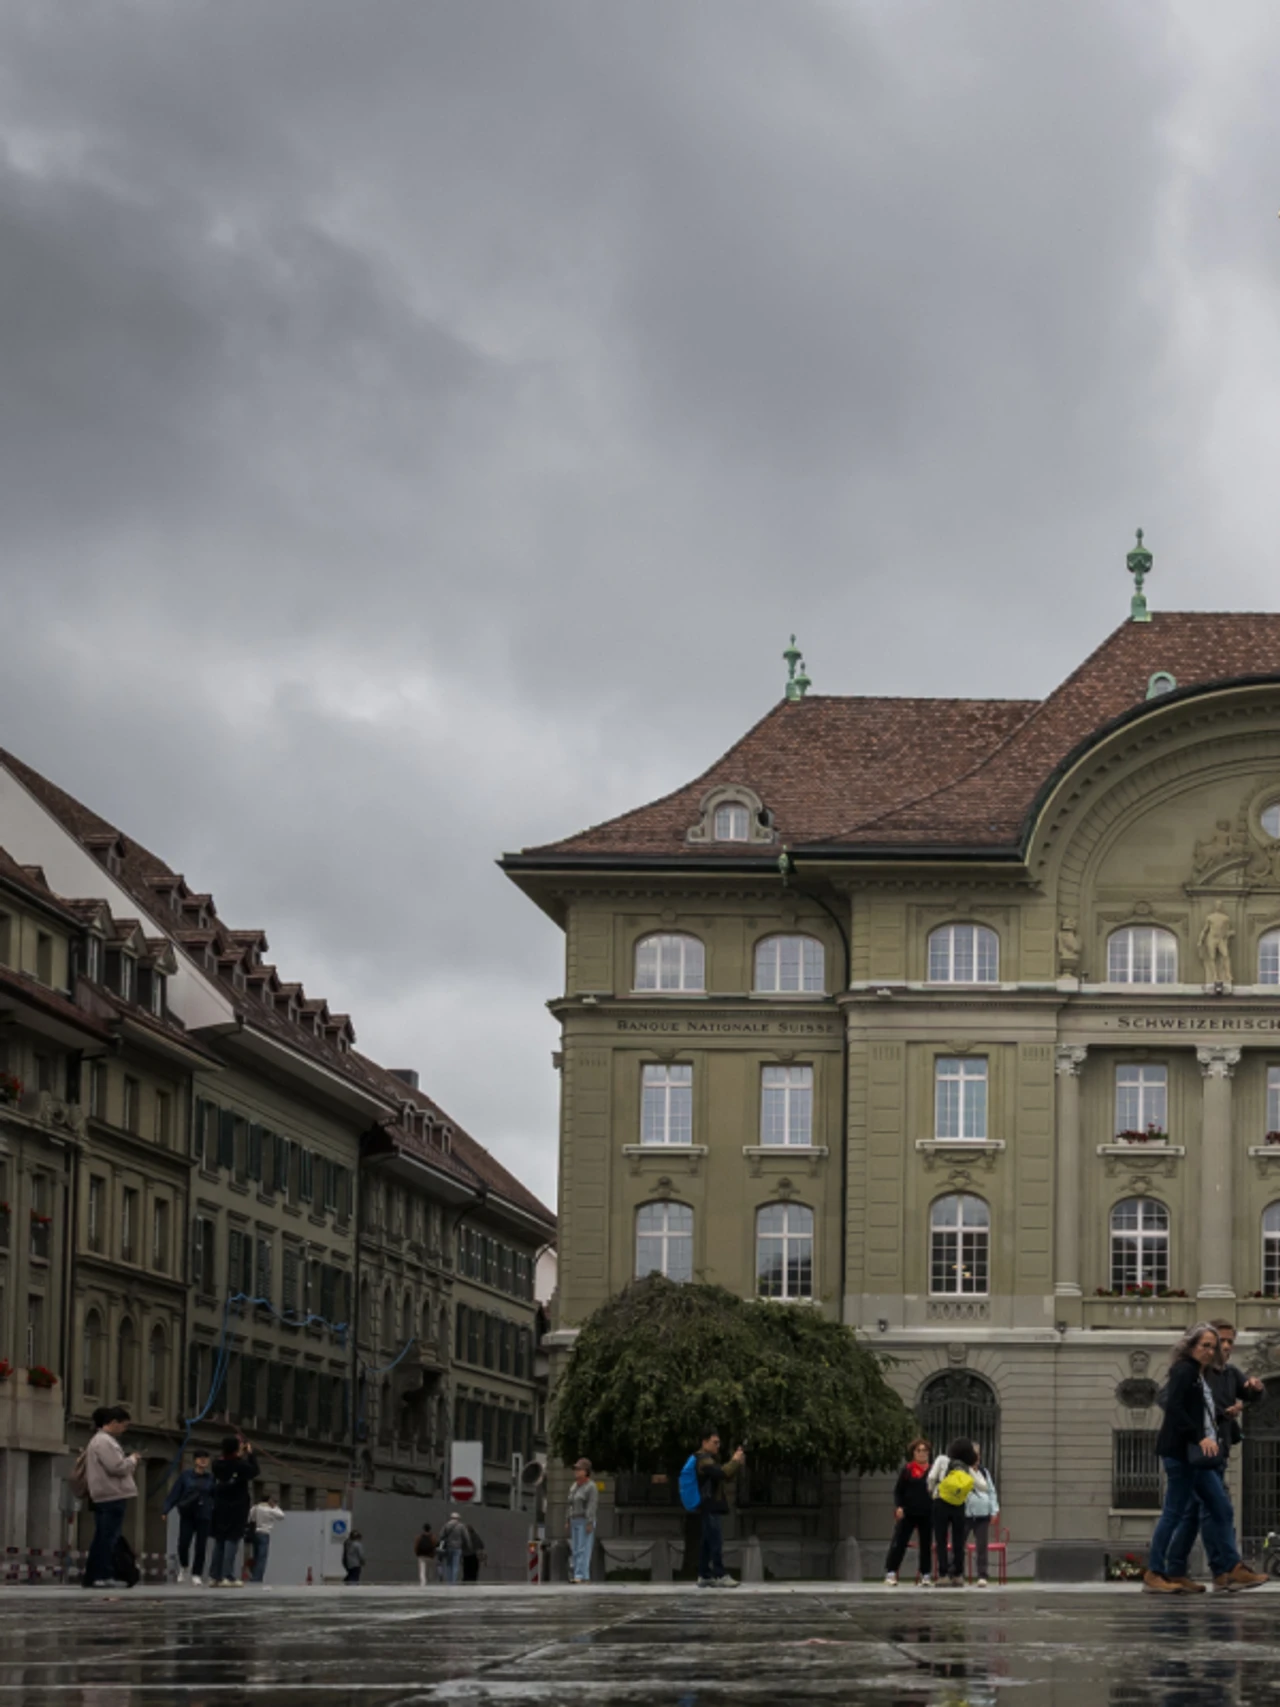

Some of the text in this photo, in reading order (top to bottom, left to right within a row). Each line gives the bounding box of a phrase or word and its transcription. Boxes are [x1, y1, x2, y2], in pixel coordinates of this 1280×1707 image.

[617, 1019, 834, 1034] BANQUE NATIONALE SUISSE
